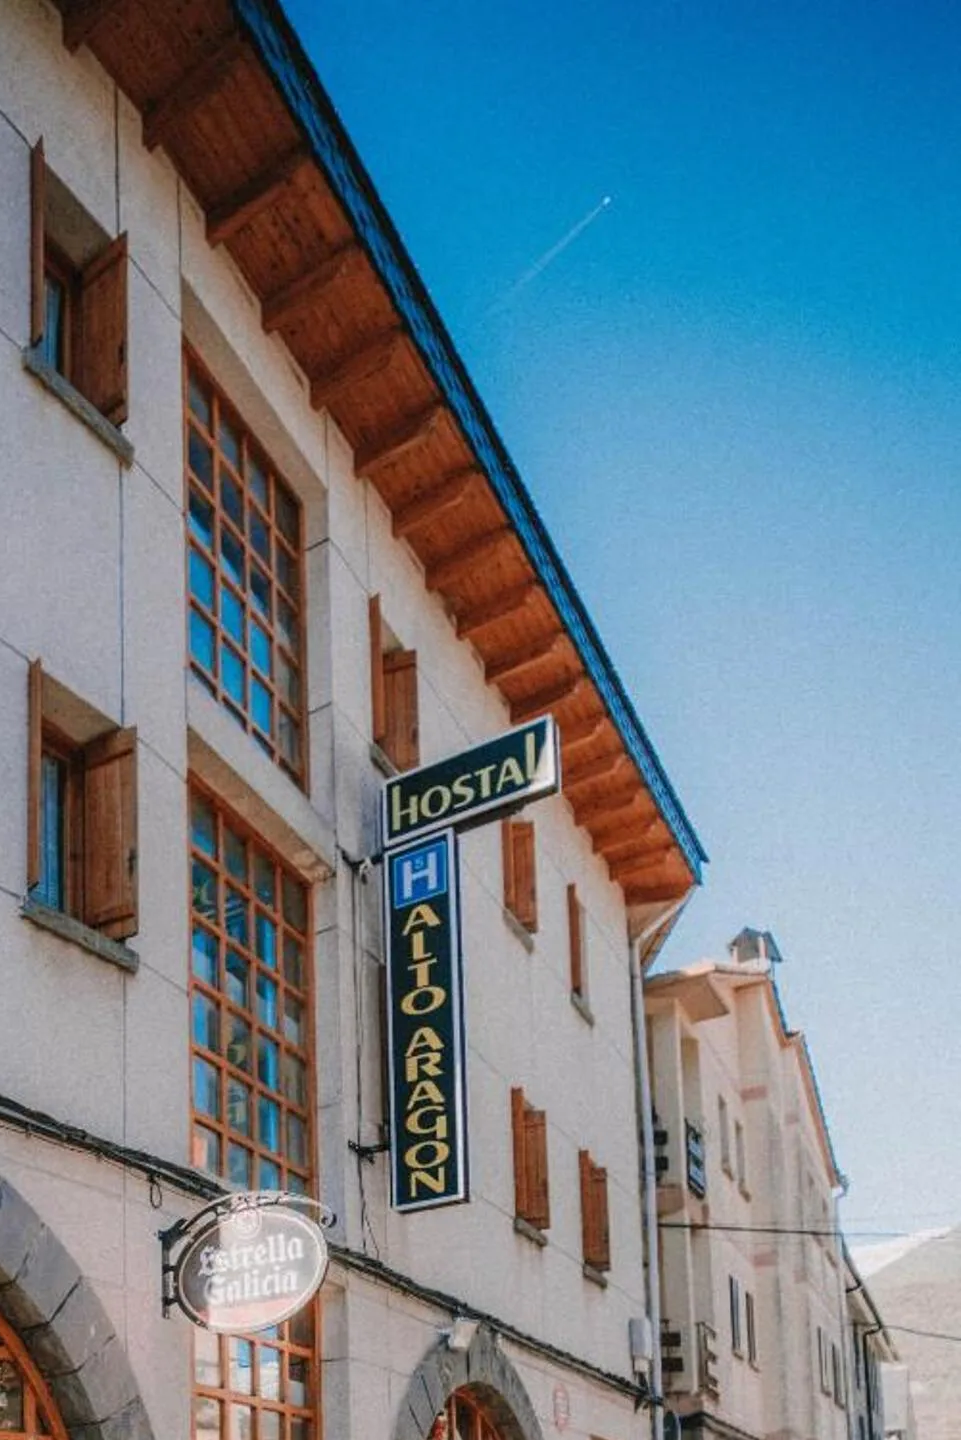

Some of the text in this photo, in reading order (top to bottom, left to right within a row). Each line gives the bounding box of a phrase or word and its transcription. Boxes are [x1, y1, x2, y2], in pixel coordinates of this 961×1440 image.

[402, 851, 437, 899] H
[401, 904, 450, 1198] ALTO ARAGON
[198, 1233, 304, 1276] Estrella
[204, 1265, 299, 1304] Galicia
